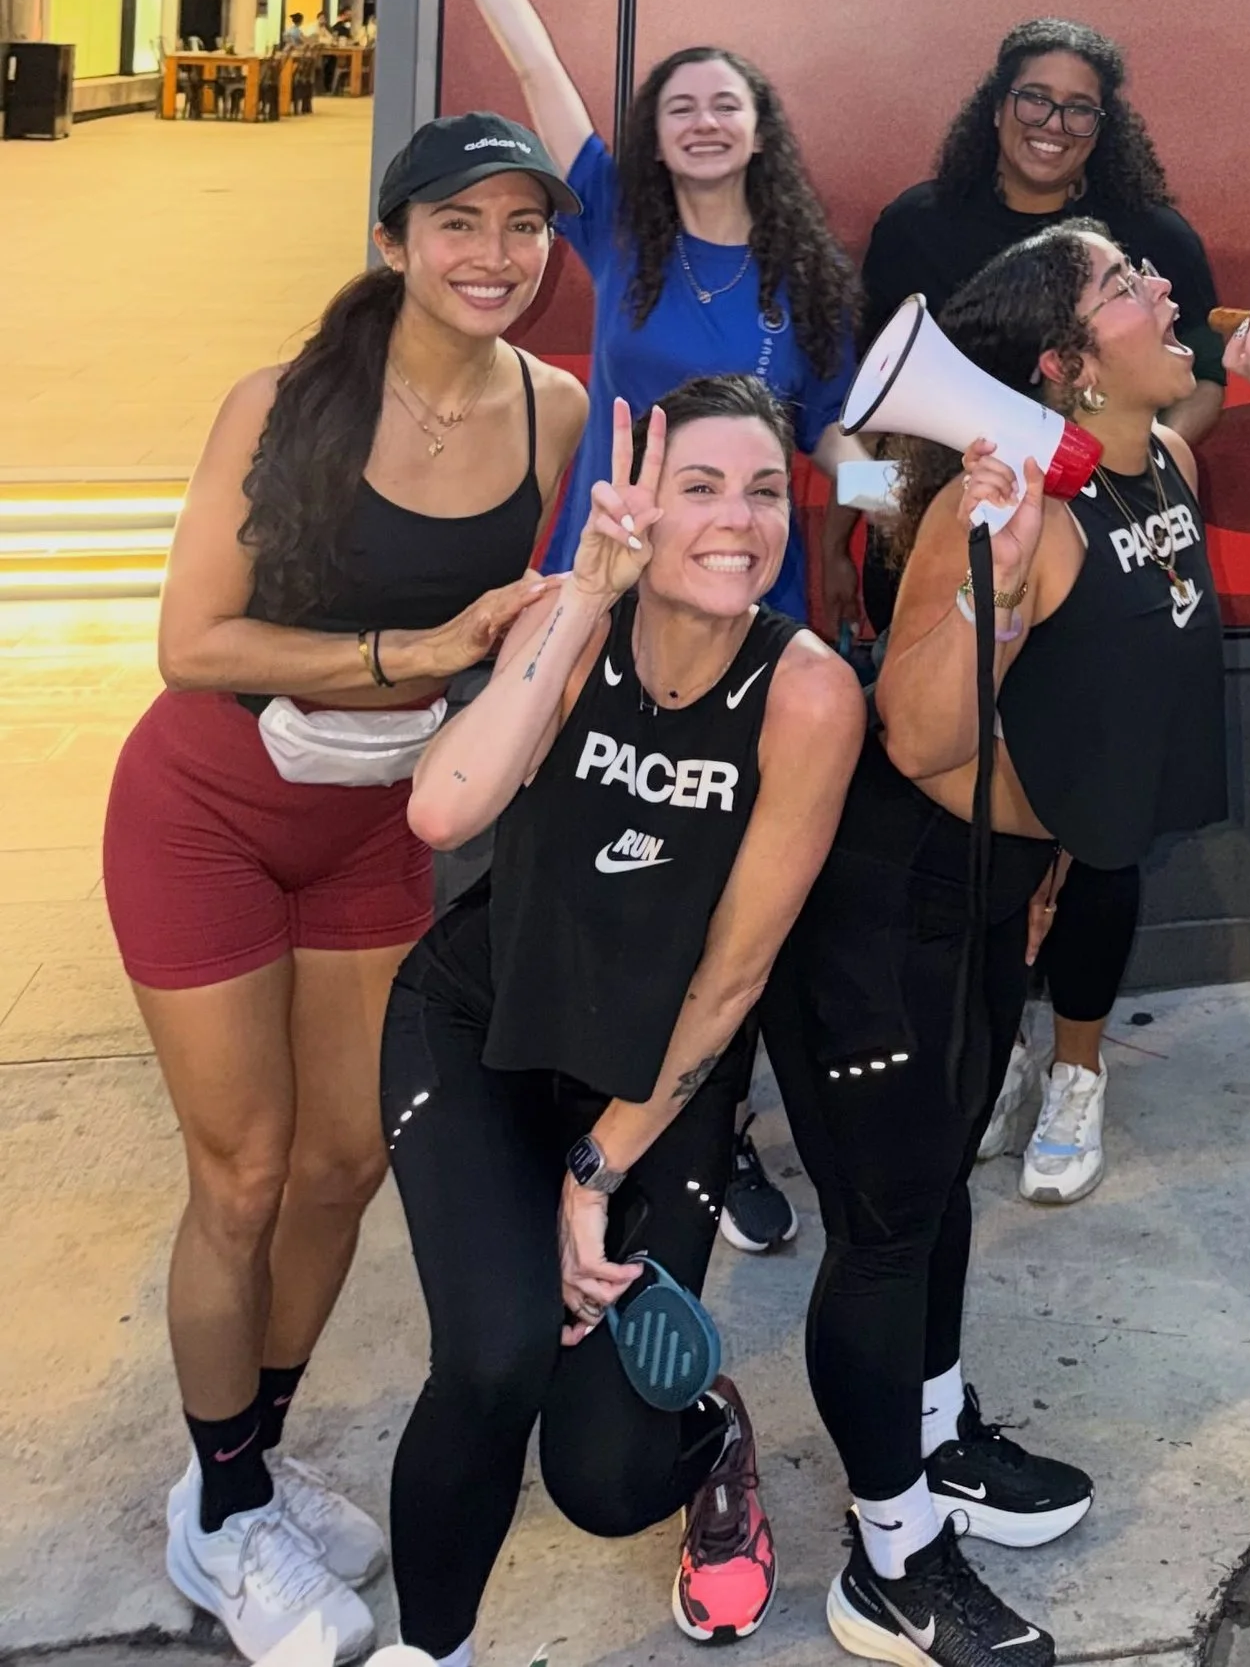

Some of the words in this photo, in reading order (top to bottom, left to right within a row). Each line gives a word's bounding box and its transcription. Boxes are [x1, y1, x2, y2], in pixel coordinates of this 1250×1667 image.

[464, 137, 516, 151] adidas
[1108, 504, 1201, 574] PACER
[575, 730, 740, 812] PACER
[612, 828, 664, 861] RUN
